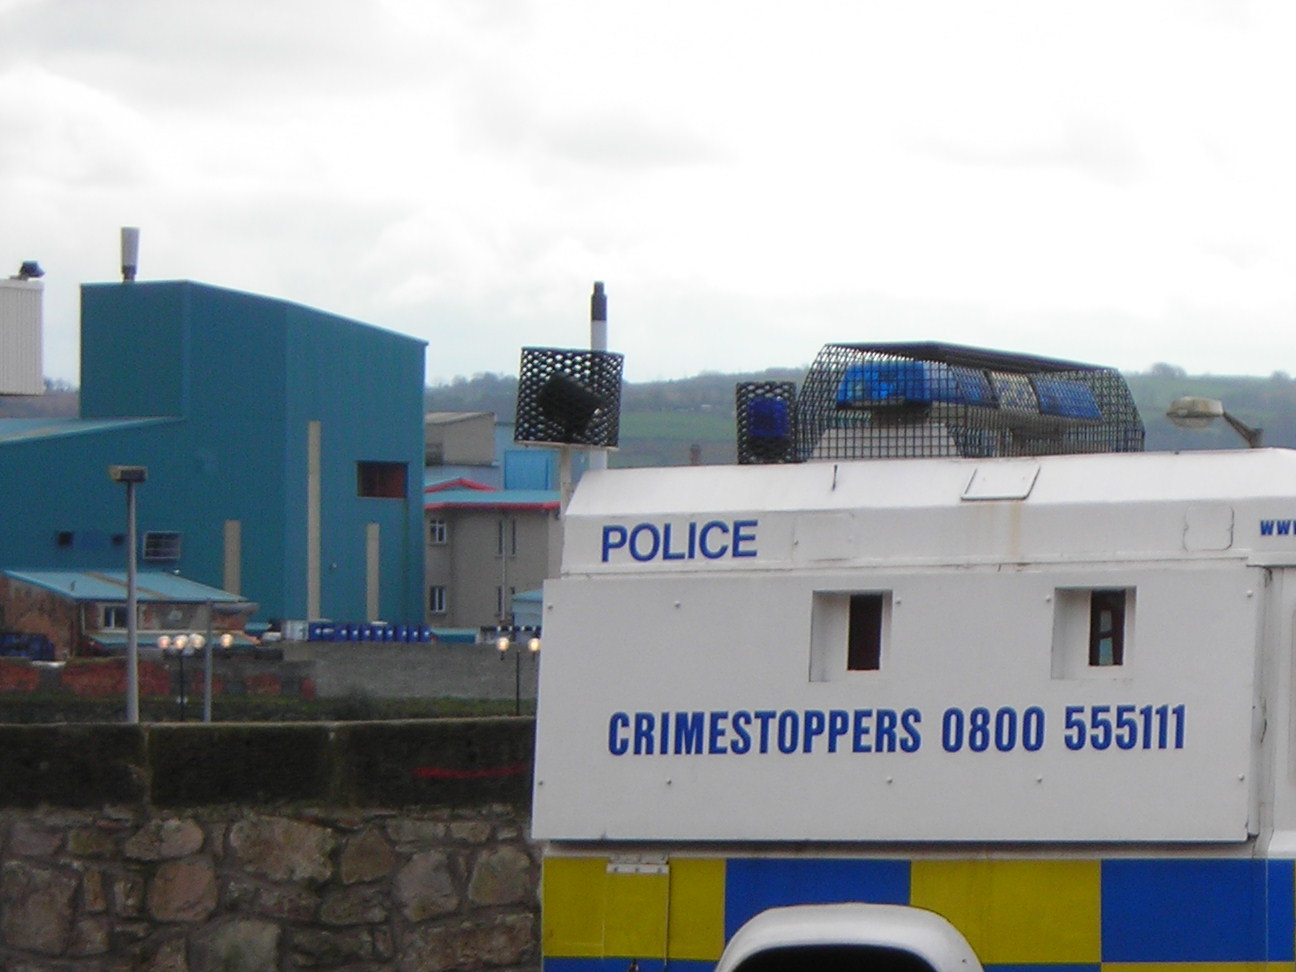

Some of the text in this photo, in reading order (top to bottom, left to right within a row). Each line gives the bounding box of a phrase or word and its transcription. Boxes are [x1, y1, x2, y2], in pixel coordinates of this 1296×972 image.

[601, 519, 759, 563] POLICE
[608, 704, 1186, 756] CRIMESTOPPERS 0800 555111
